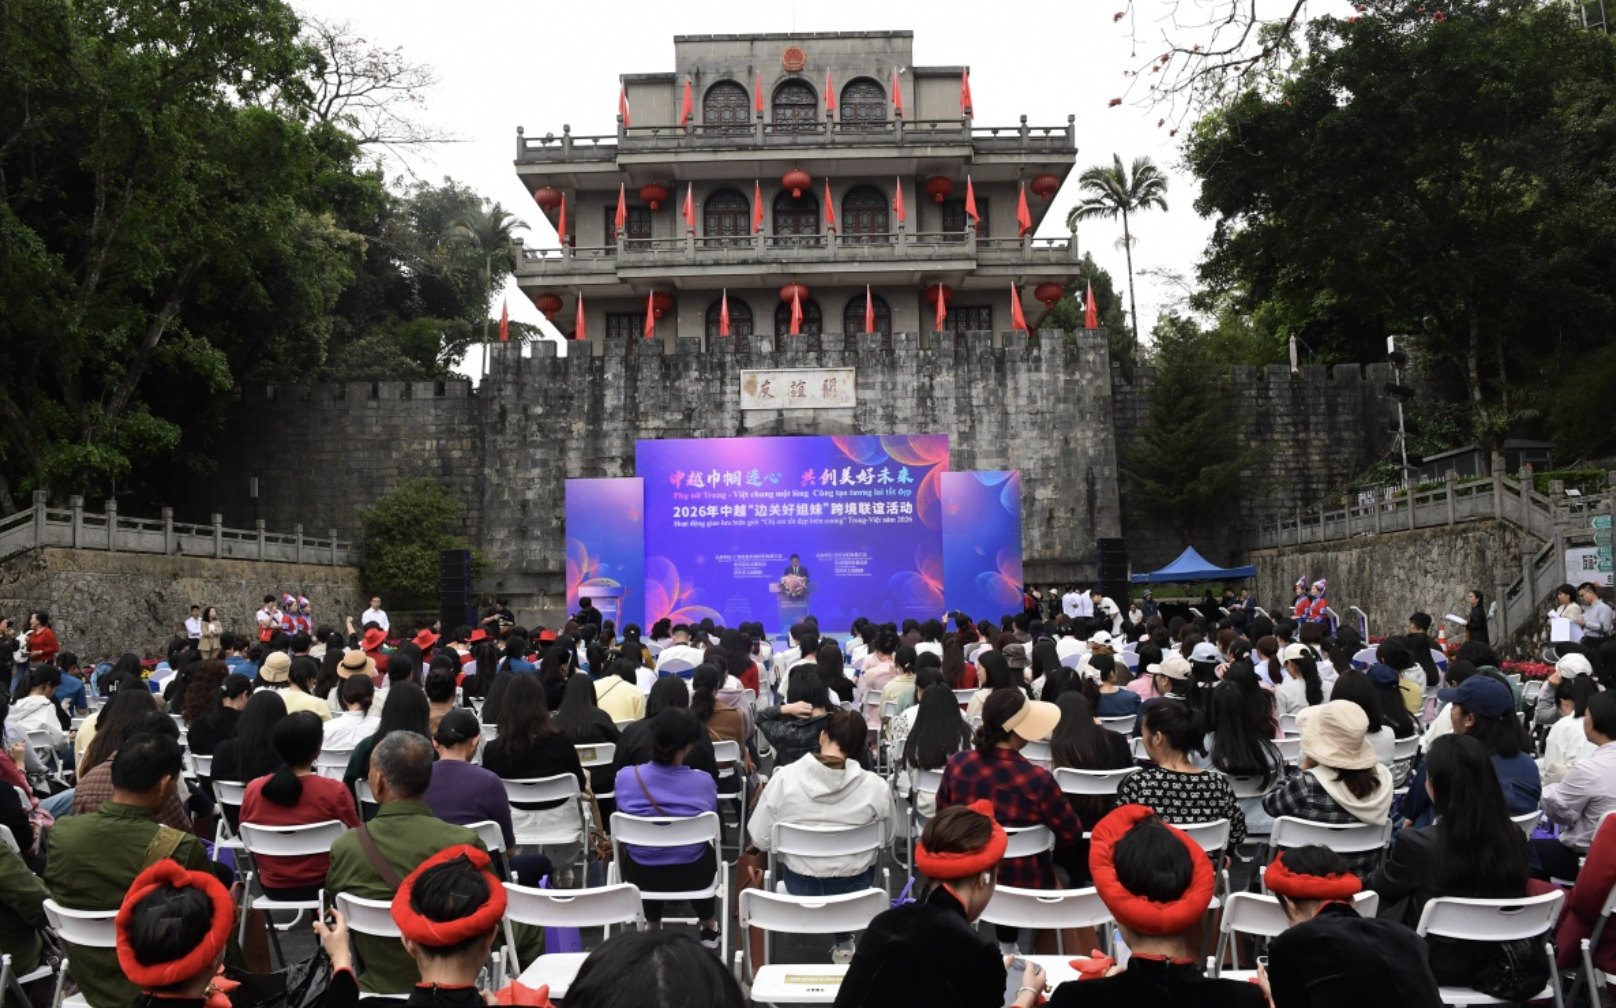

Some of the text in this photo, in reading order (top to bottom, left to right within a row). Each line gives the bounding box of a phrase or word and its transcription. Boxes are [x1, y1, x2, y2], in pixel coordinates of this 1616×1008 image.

[801, 466, 914, 487] 共创美好未来
[702, 492, 726, 500] Trung
[750, 490, 774, 499] chung
